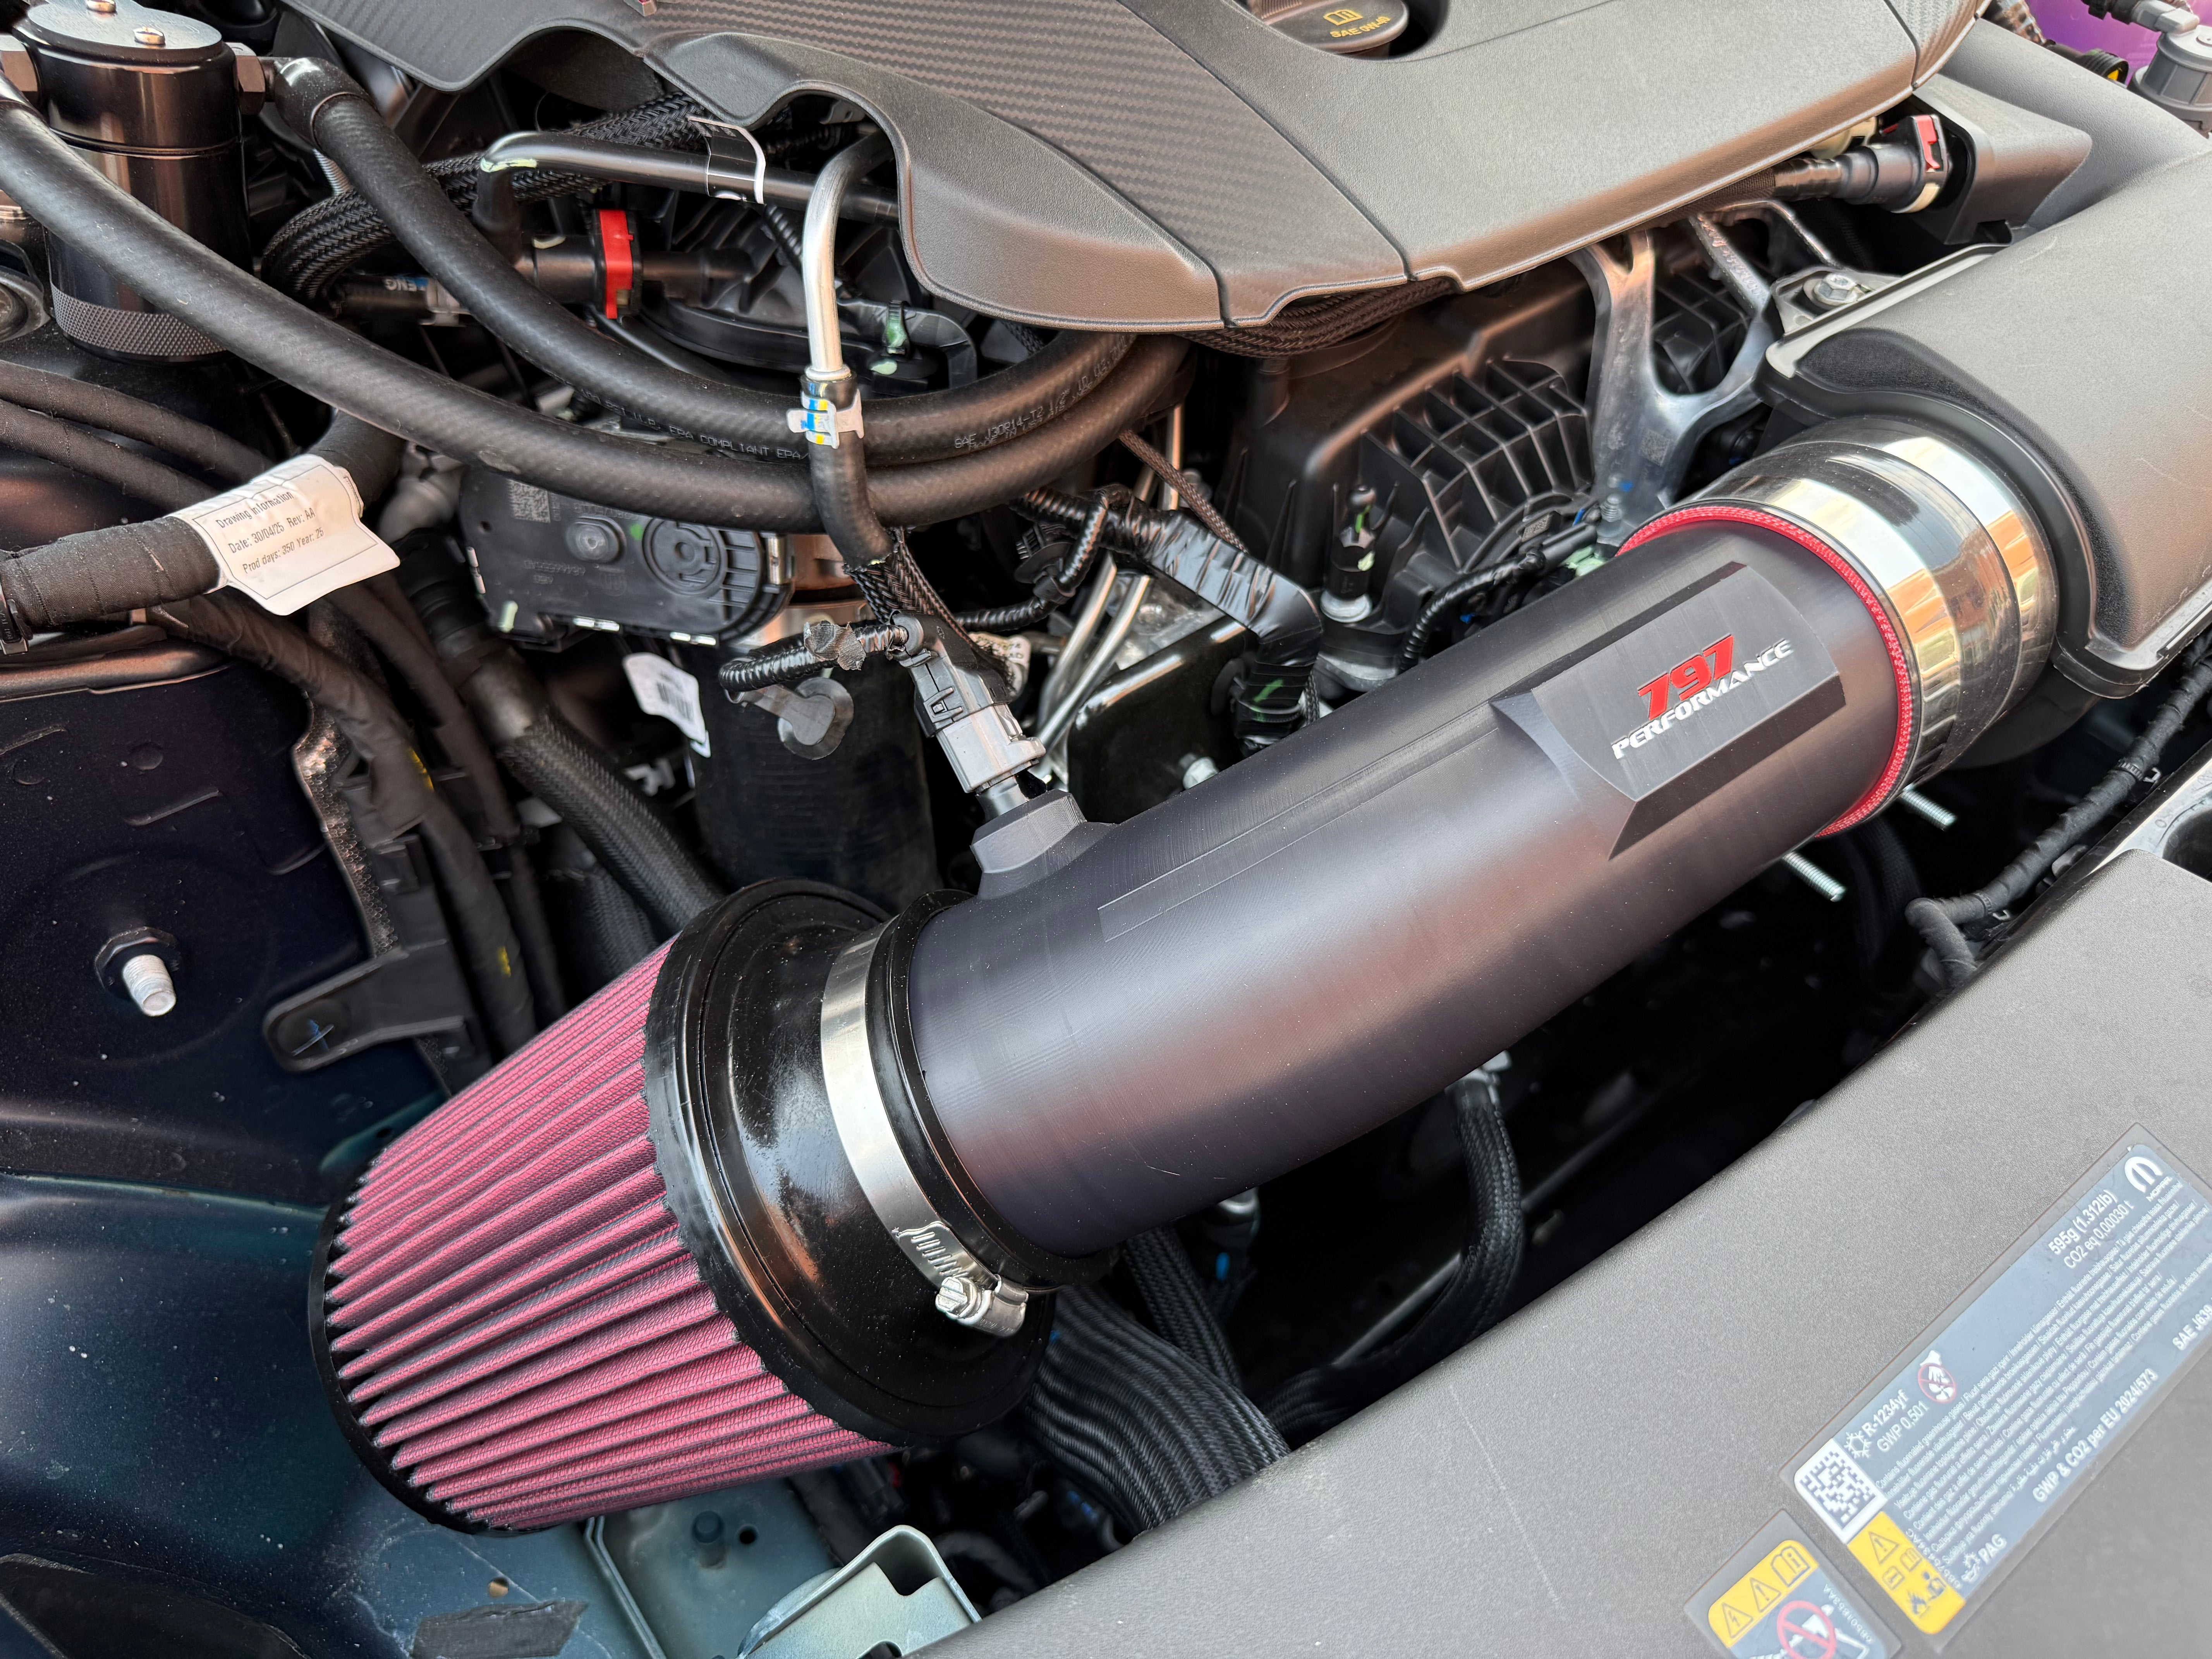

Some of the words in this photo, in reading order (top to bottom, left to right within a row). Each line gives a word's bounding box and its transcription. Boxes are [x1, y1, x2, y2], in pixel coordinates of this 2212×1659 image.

[1330, 27, 1363, 38] SAE
[669, 426, 694, 440] EPA
[700, 435, 770, 457] COMPLIANT
[954, 433, 977, 449] SAE
[216, 509, 252, 529] Drawing
[251, 491, 294, 515] information
[228, 538, 252, 553] Date:
[251, 522, 285, 543] 30/04/25
[286, 514, 305, 528] Rev:
[304, 507, 316, 520] AA
[242, 558, 260, 575] Prod
[262, 549, 281, 565] days:
[282, 541, 295, 555] 350
[296, 533, 315, 548] Year:
[315, 527, 324, 539] 25
[1611, 639, 1795, 759] PERFORMANCE
[1638, 634, 1734, 720] 797
[2048, 1228, 2080, 1255] 595g
[2072, 1189, 2118, 1233] (1.312lb)
[2063, 1245, 2088, 1269] CO2
[2084, 1236, 2101, 1250] eq
[2093, 1204, 2129, 1239] 0,00030
[2172, 1324, 2198, 1350] SAE
[2192, 1304, 2212, 1331] J639
[1862, 1389, 1908, 1437] R-1234yf
[1877, 1424, 1902, 1452] GWP
[1900, 1400, 1929, 1429] 0,501
[2032, 1471, 2059, 1502] GWP
[2056, 1463, 2071, 1477] &
[2065, 1440, 2092, 1467] CO2
[2087, 1424, 2106, 1448] per
[2100, 1407, 2121, 1429] EU
[2115, 1368, 2158, 1413] 2024/573
[1875, 1466, 1900, 1490] Contains
[1896, 1440, 1924, 1469] fluorinated
[1922, 1415, 1951, 1446] greenhouse
[1948, 1401, 1965, 1419] gases
[1978, 1534, 2007, 1564] PAG
